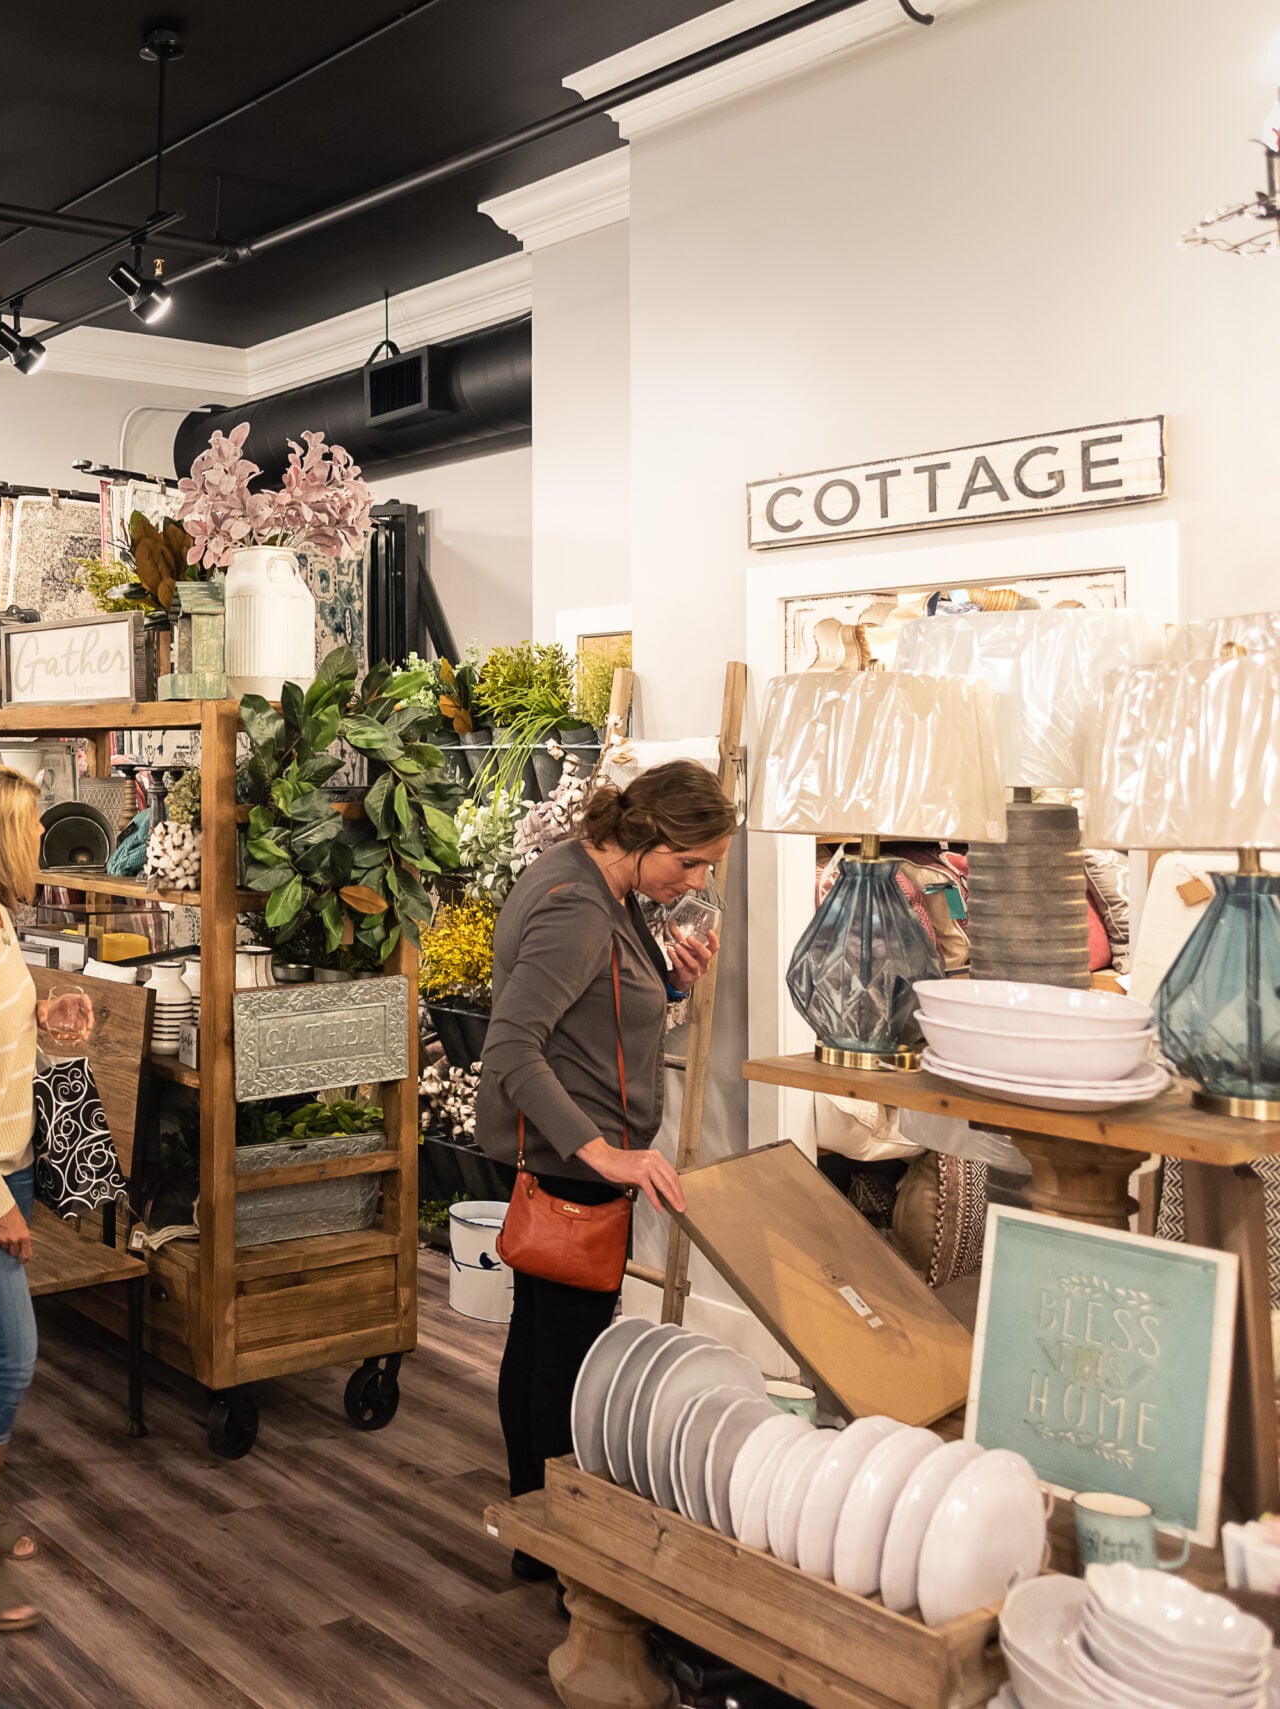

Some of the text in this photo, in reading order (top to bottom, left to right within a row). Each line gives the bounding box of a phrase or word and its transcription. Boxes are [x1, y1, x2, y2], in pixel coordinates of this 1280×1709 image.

[765, 434, 1123, 533] COTTAGE
[14, 627, 130, 694] Gather
[266, 1017, 377, 1056] GATHER
[1037, 1288, 1161, 1359] BLESS
[1028, 1369, 1159, 1451] HOME
